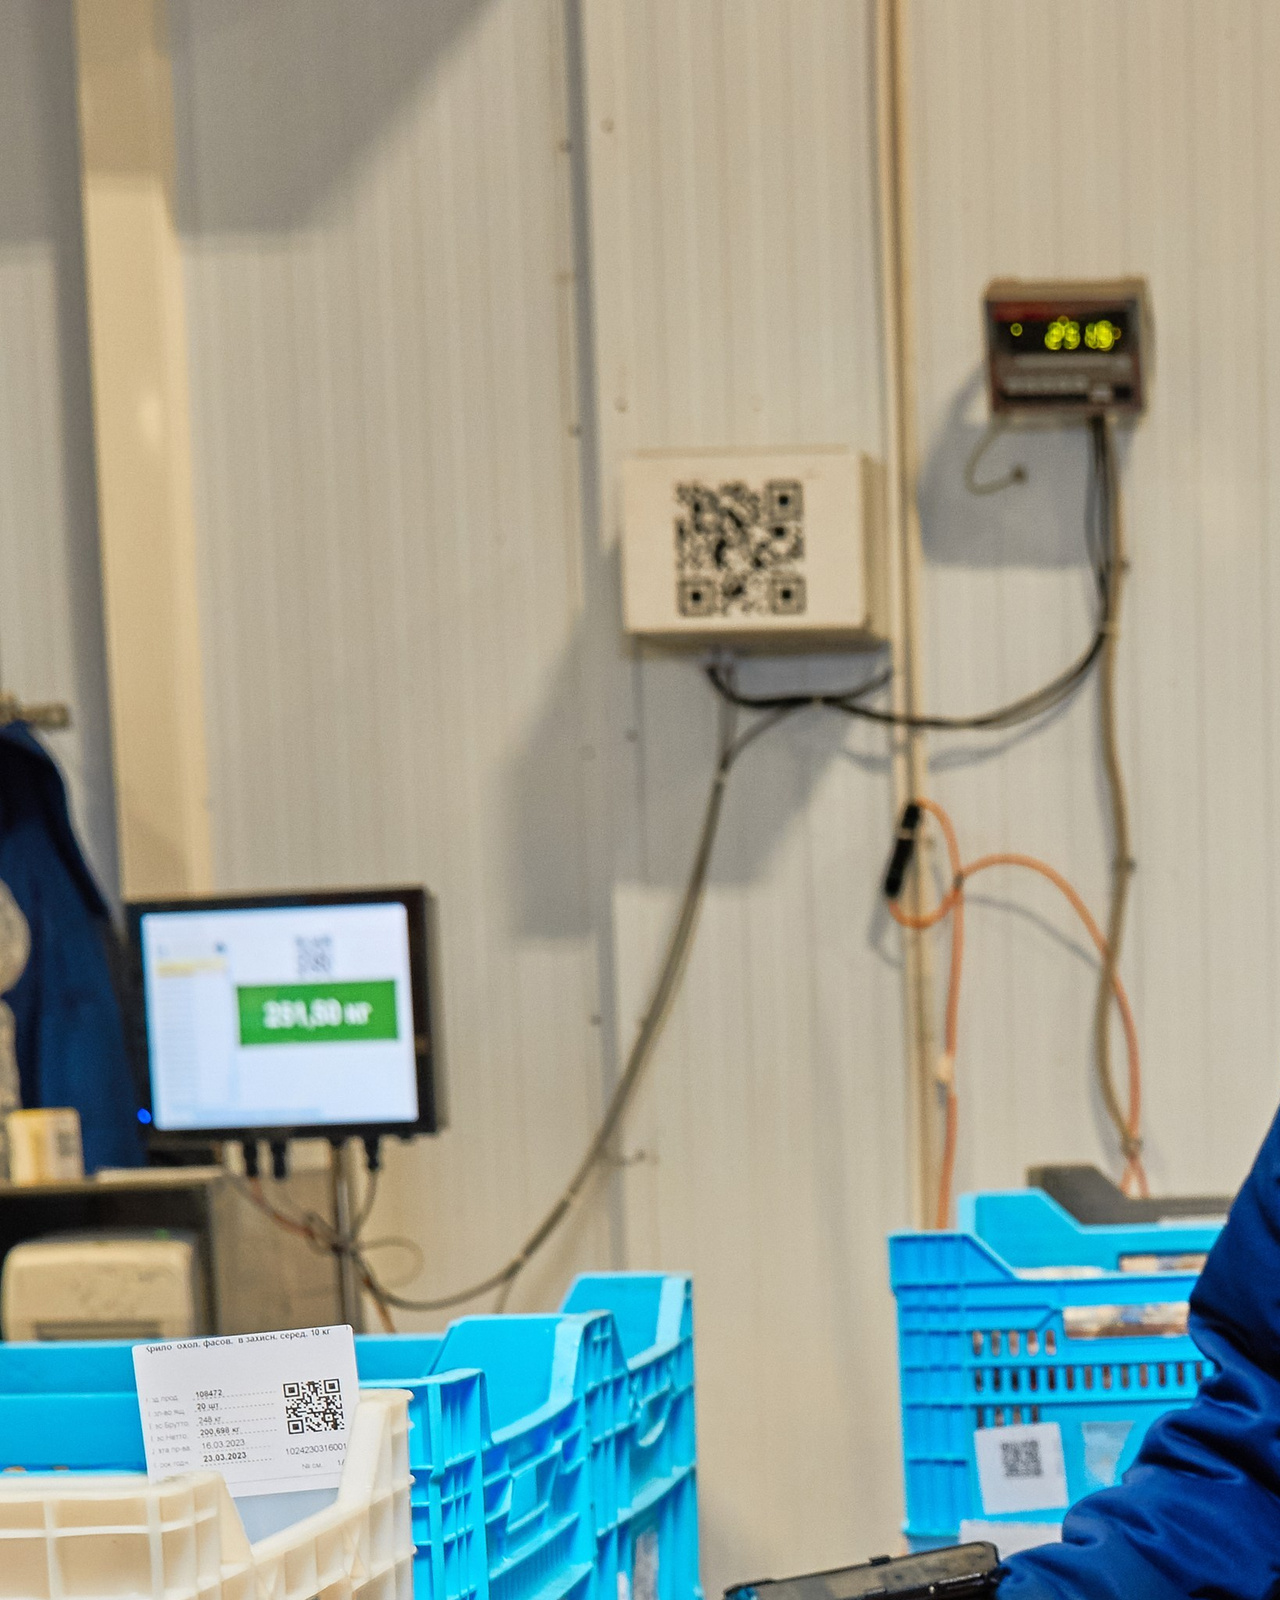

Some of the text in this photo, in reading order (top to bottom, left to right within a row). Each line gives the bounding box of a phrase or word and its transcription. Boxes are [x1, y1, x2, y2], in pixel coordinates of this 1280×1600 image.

[203, 1338, 233, 1348] фасов.
[280, 1331, 308, 1341] серед.
[311, 1329, 320, 1337] 10
[195, 1389, 223, 1398] 108472
[196, 1403, 206, 1411] 20
[202, 1439, 246, 1450] 16.03.2023
[203, 1452, 247, 1463] 23.03.2023
